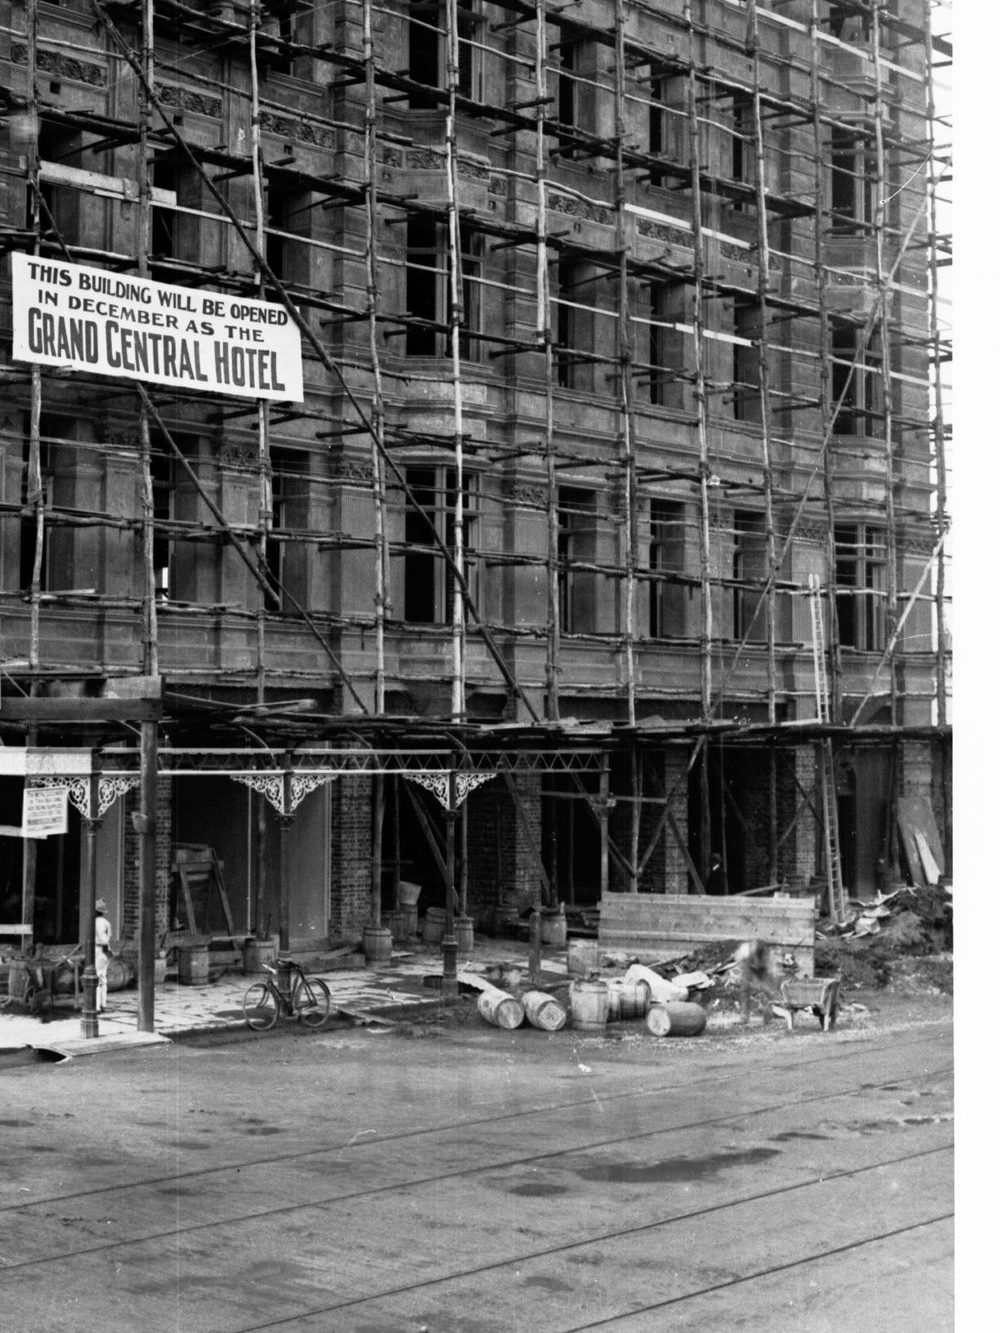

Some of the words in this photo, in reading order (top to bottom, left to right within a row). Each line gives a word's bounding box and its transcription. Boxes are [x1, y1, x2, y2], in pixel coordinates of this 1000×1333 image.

[27, 262, 73, 287] THIS
[78, 272, 152, 305] BUILDING
[157, 289, 197, 313] WILL
[202, 298, 226, 318] BE
[230, 303, 289, 327] OPENED
[38, 289, 58, 307] IN
[68, 295, 179, 330] DECEMBER
[185, 319, 215, 336] AS
[224, 325, 265, 343] THE
[28, 306, 99, 364] GRAND
[105, 319, 208, 382] CENTRAL
[213, 340, 286, 392] HOTEL
